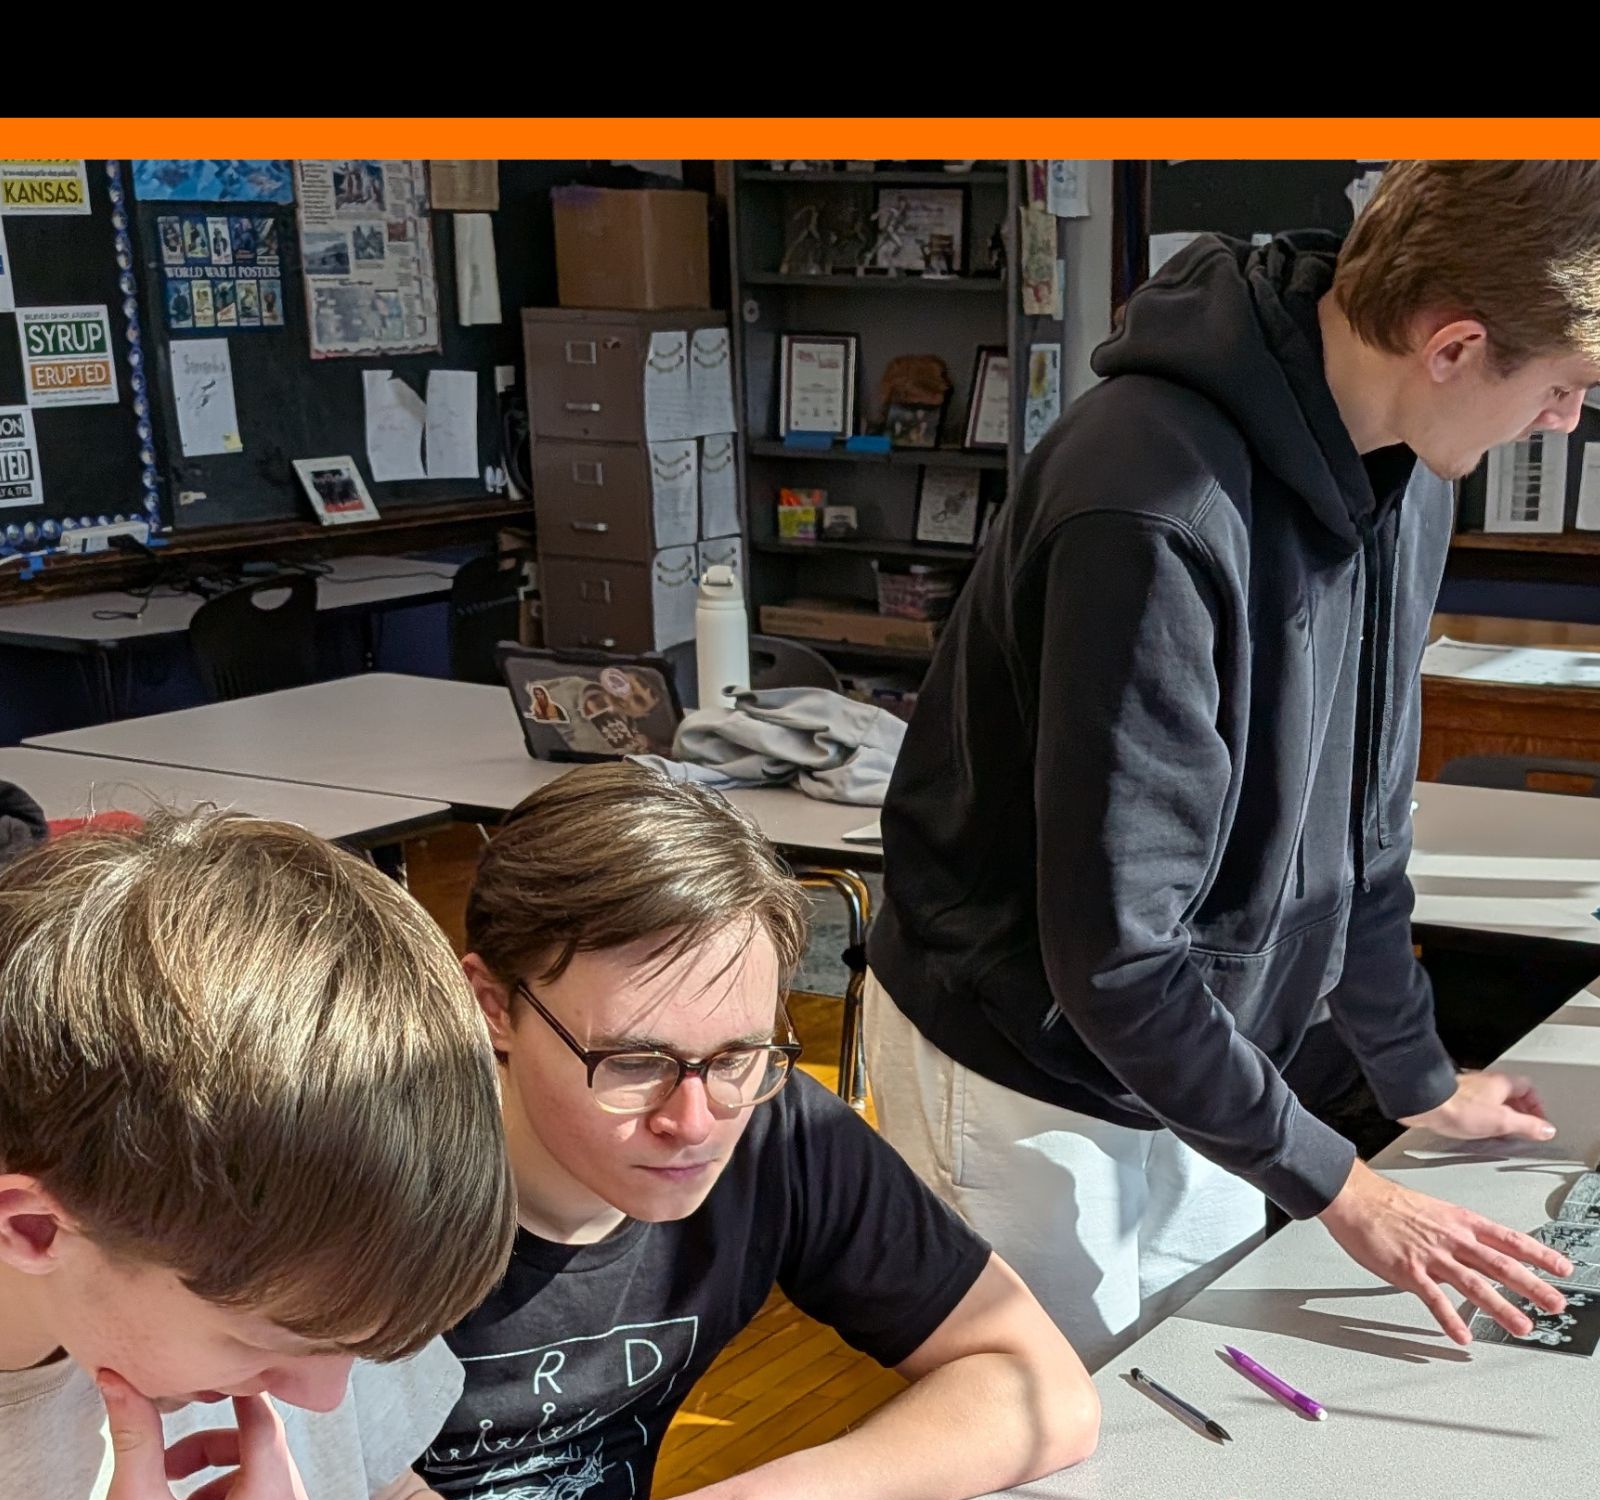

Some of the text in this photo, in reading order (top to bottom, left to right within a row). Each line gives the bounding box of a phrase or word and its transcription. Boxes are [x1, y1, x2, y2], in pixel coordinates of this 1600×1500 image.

[3, 181, 84, 204] KANSAS.
[164, 266, 203, 278] WORLD
[28, 322, 102, 353] SYRUP
[35, 363, 106, 386] ERUPTED
